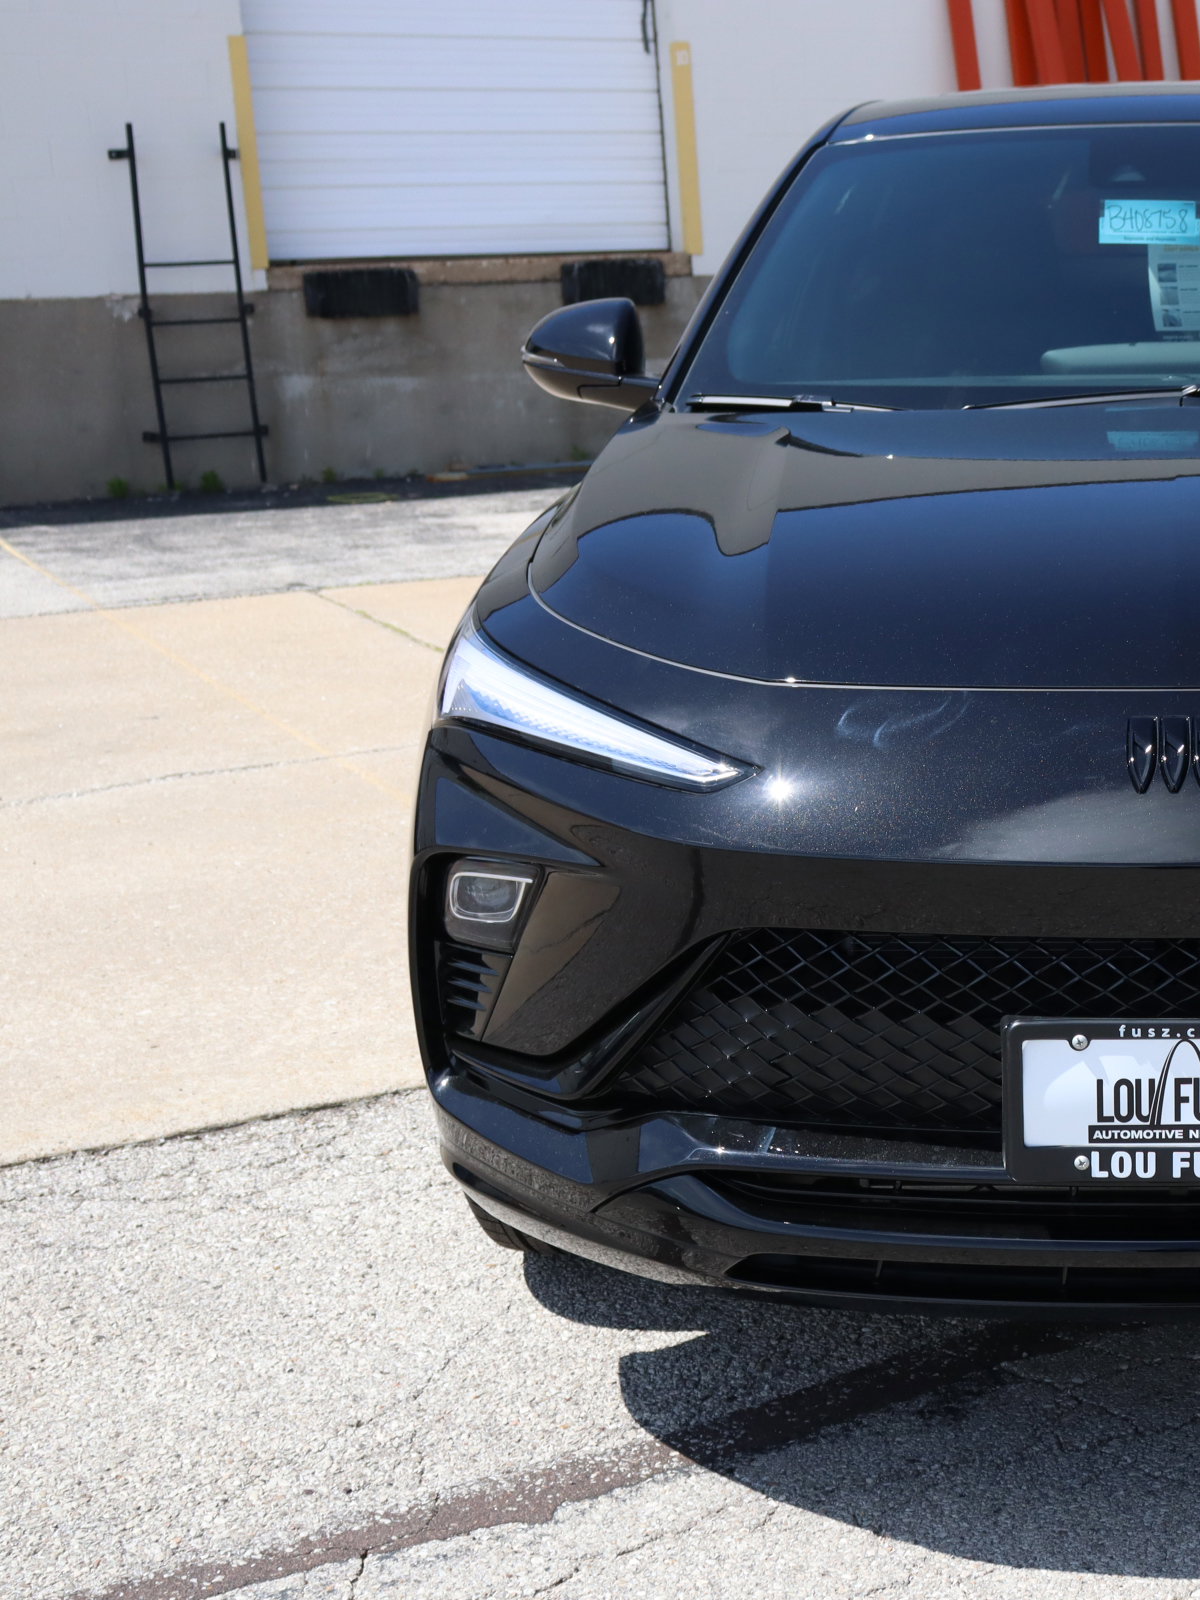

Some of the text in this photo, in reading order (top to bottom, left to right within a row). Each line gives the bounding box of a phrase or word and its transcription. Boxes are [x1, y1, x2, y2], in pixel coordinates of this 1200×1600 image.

[1096, 1078, 1156, 1123] LOU
[1092, 1129, 1184, 1140] AUTOMOTIVE
[1090, 1150, 1157, 1179] LOU
